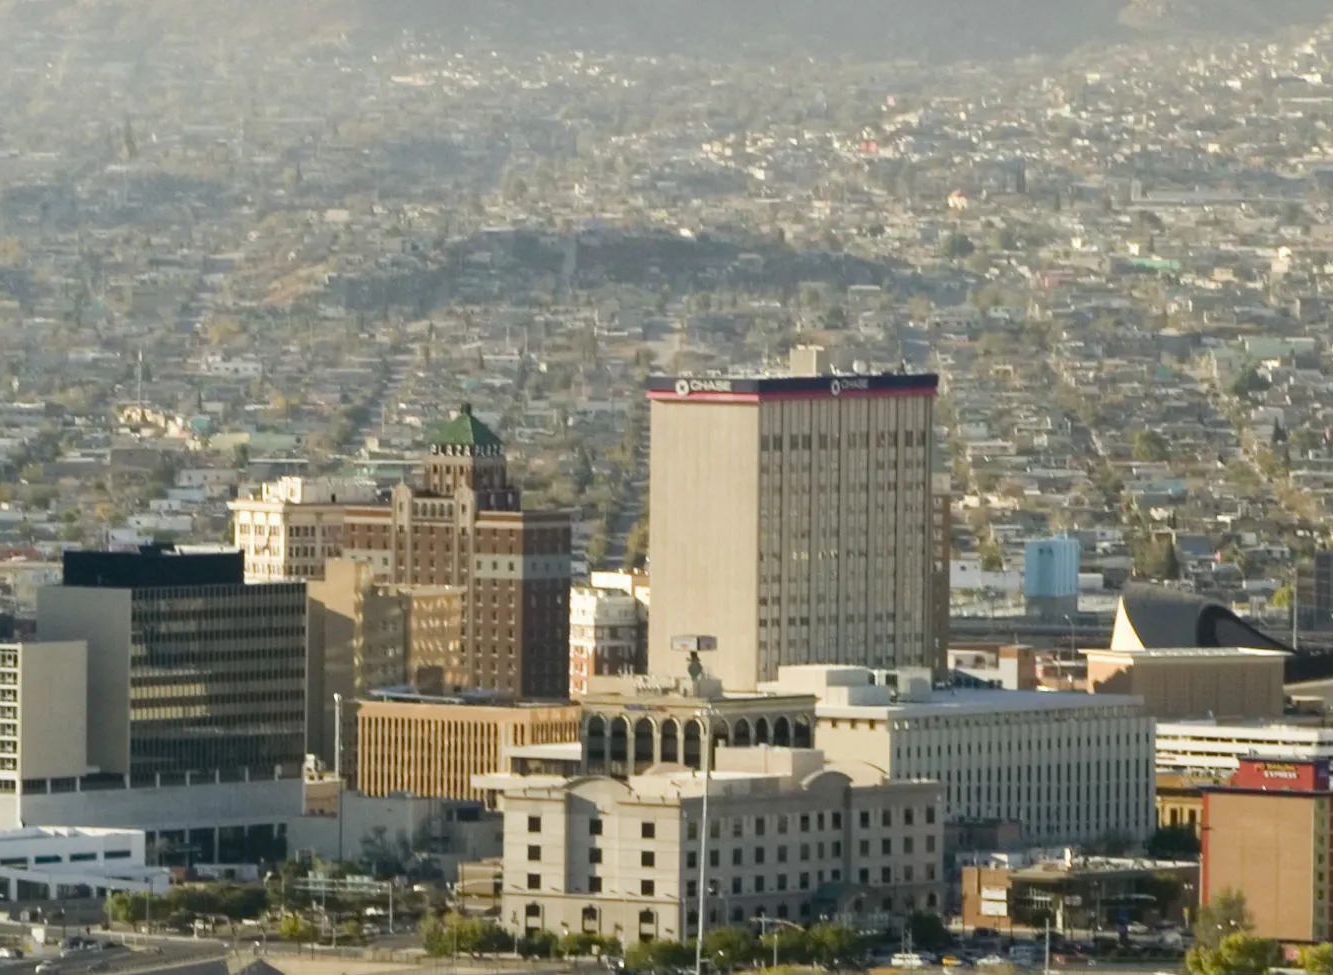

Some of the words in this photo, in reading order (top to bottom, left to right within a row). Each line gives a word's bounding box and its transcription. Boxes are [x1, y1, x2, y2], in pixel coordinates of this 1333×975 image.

[690, 379, 732, 392] CHASE
[841, 378, 869, 390] CHASE
[430, 443, 471, 457] PLAZA
[475, 443, 506, 457] PLAZA
